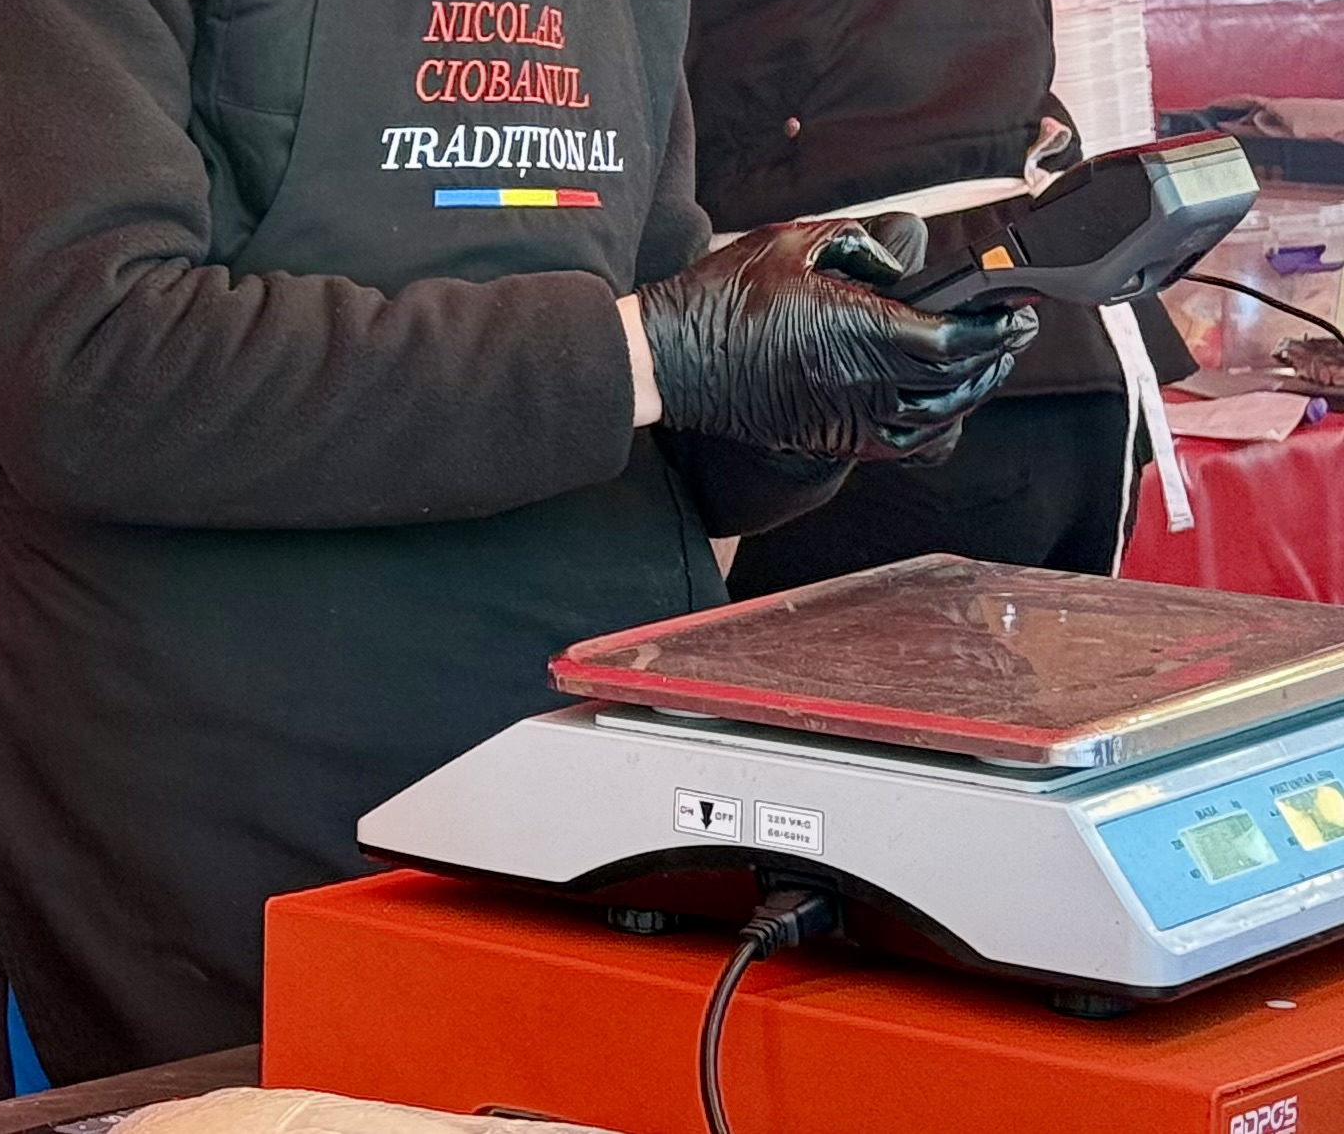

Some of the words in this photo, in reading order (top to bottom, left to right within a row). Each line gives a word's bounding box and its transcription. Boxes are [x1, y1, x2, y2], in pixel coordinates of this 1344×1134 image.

[421, 0, 566, 49] NICOLAE
[414, 59, 592, 108] CIOBANUL
[714, 811, 734, 823] OFF
